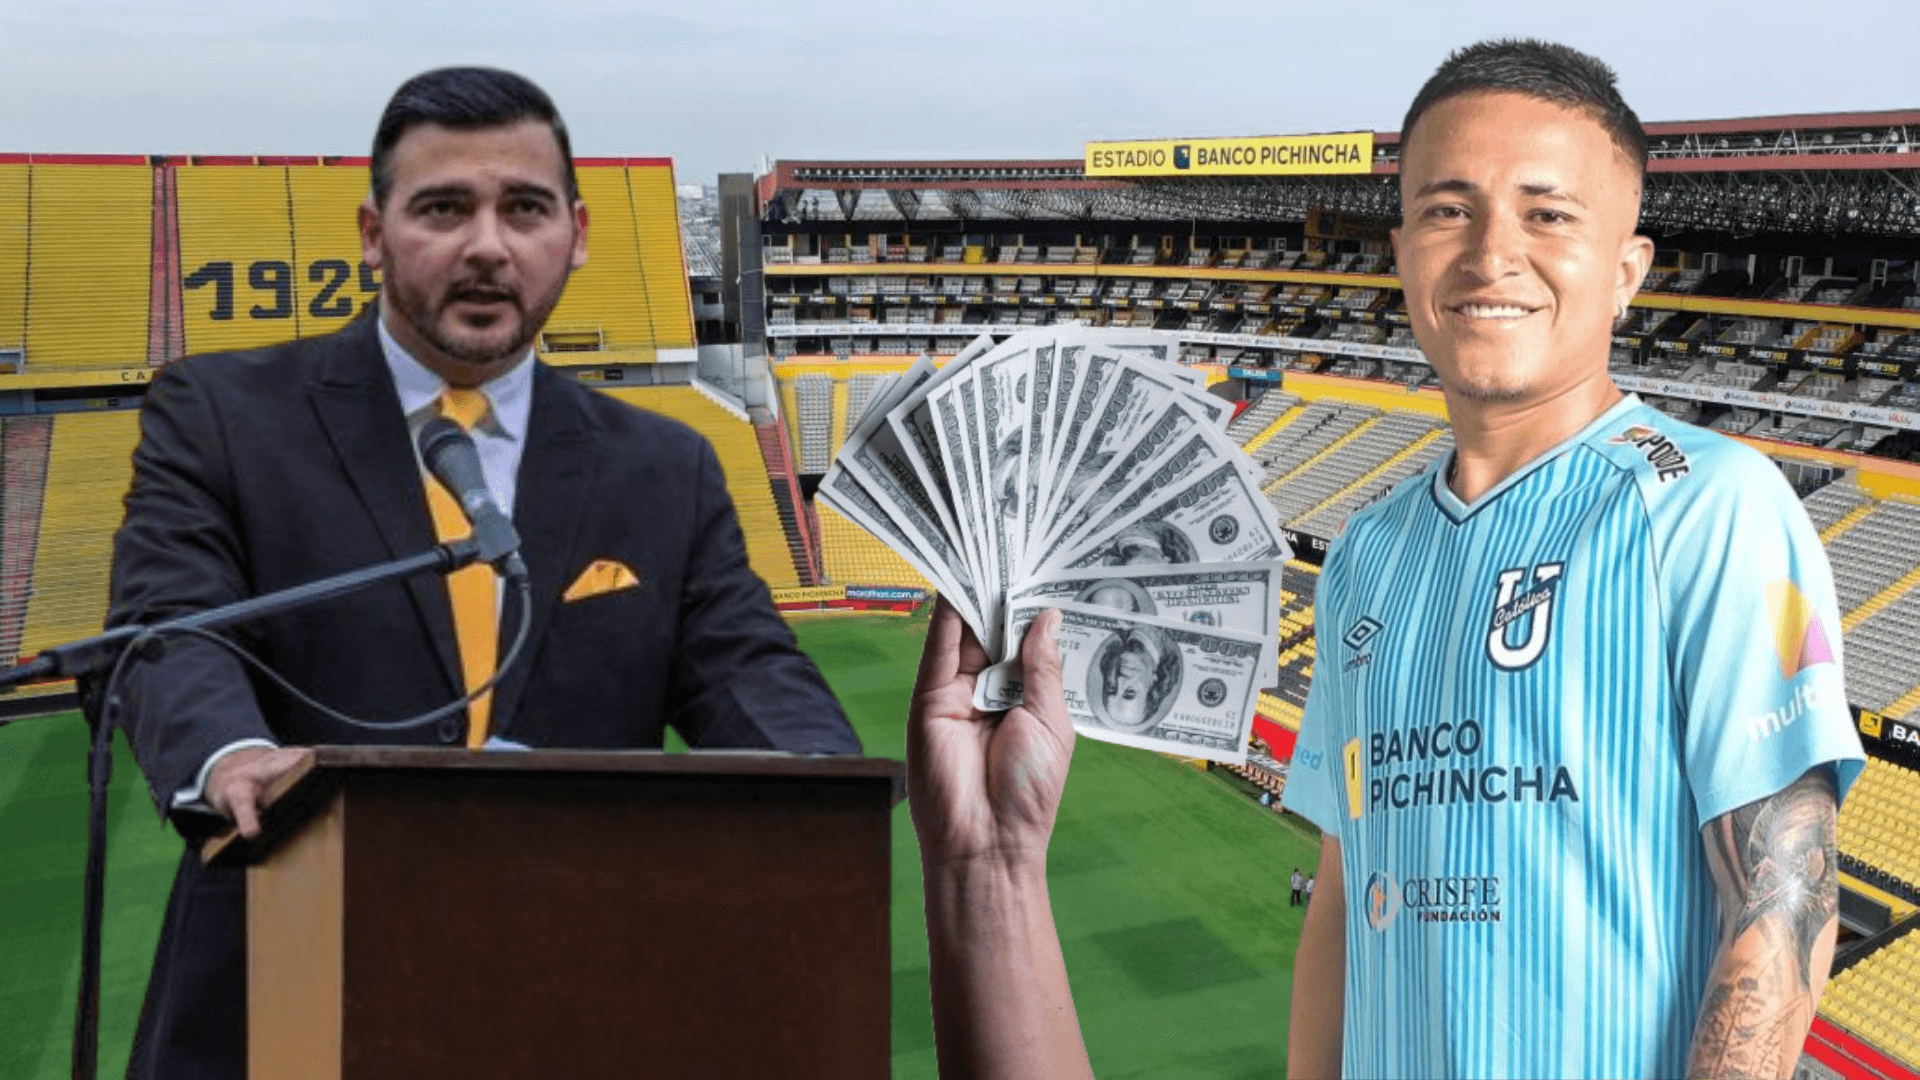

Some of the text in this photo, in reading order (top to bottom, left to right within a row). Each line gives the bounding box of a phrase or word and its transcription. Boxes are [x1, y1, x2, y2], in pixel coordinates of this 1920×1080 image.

[1092, 143, 1361, 168] ESTADIO BANCO PICHINCHA
[1371, 719, 1481, 768] BANCO
[1371, 765, 1580, 814] PICHINCHA
[1402, 877, 1501, 909] CRISFE
[1417, 908, 1501, 923] FUNDACIÓN
